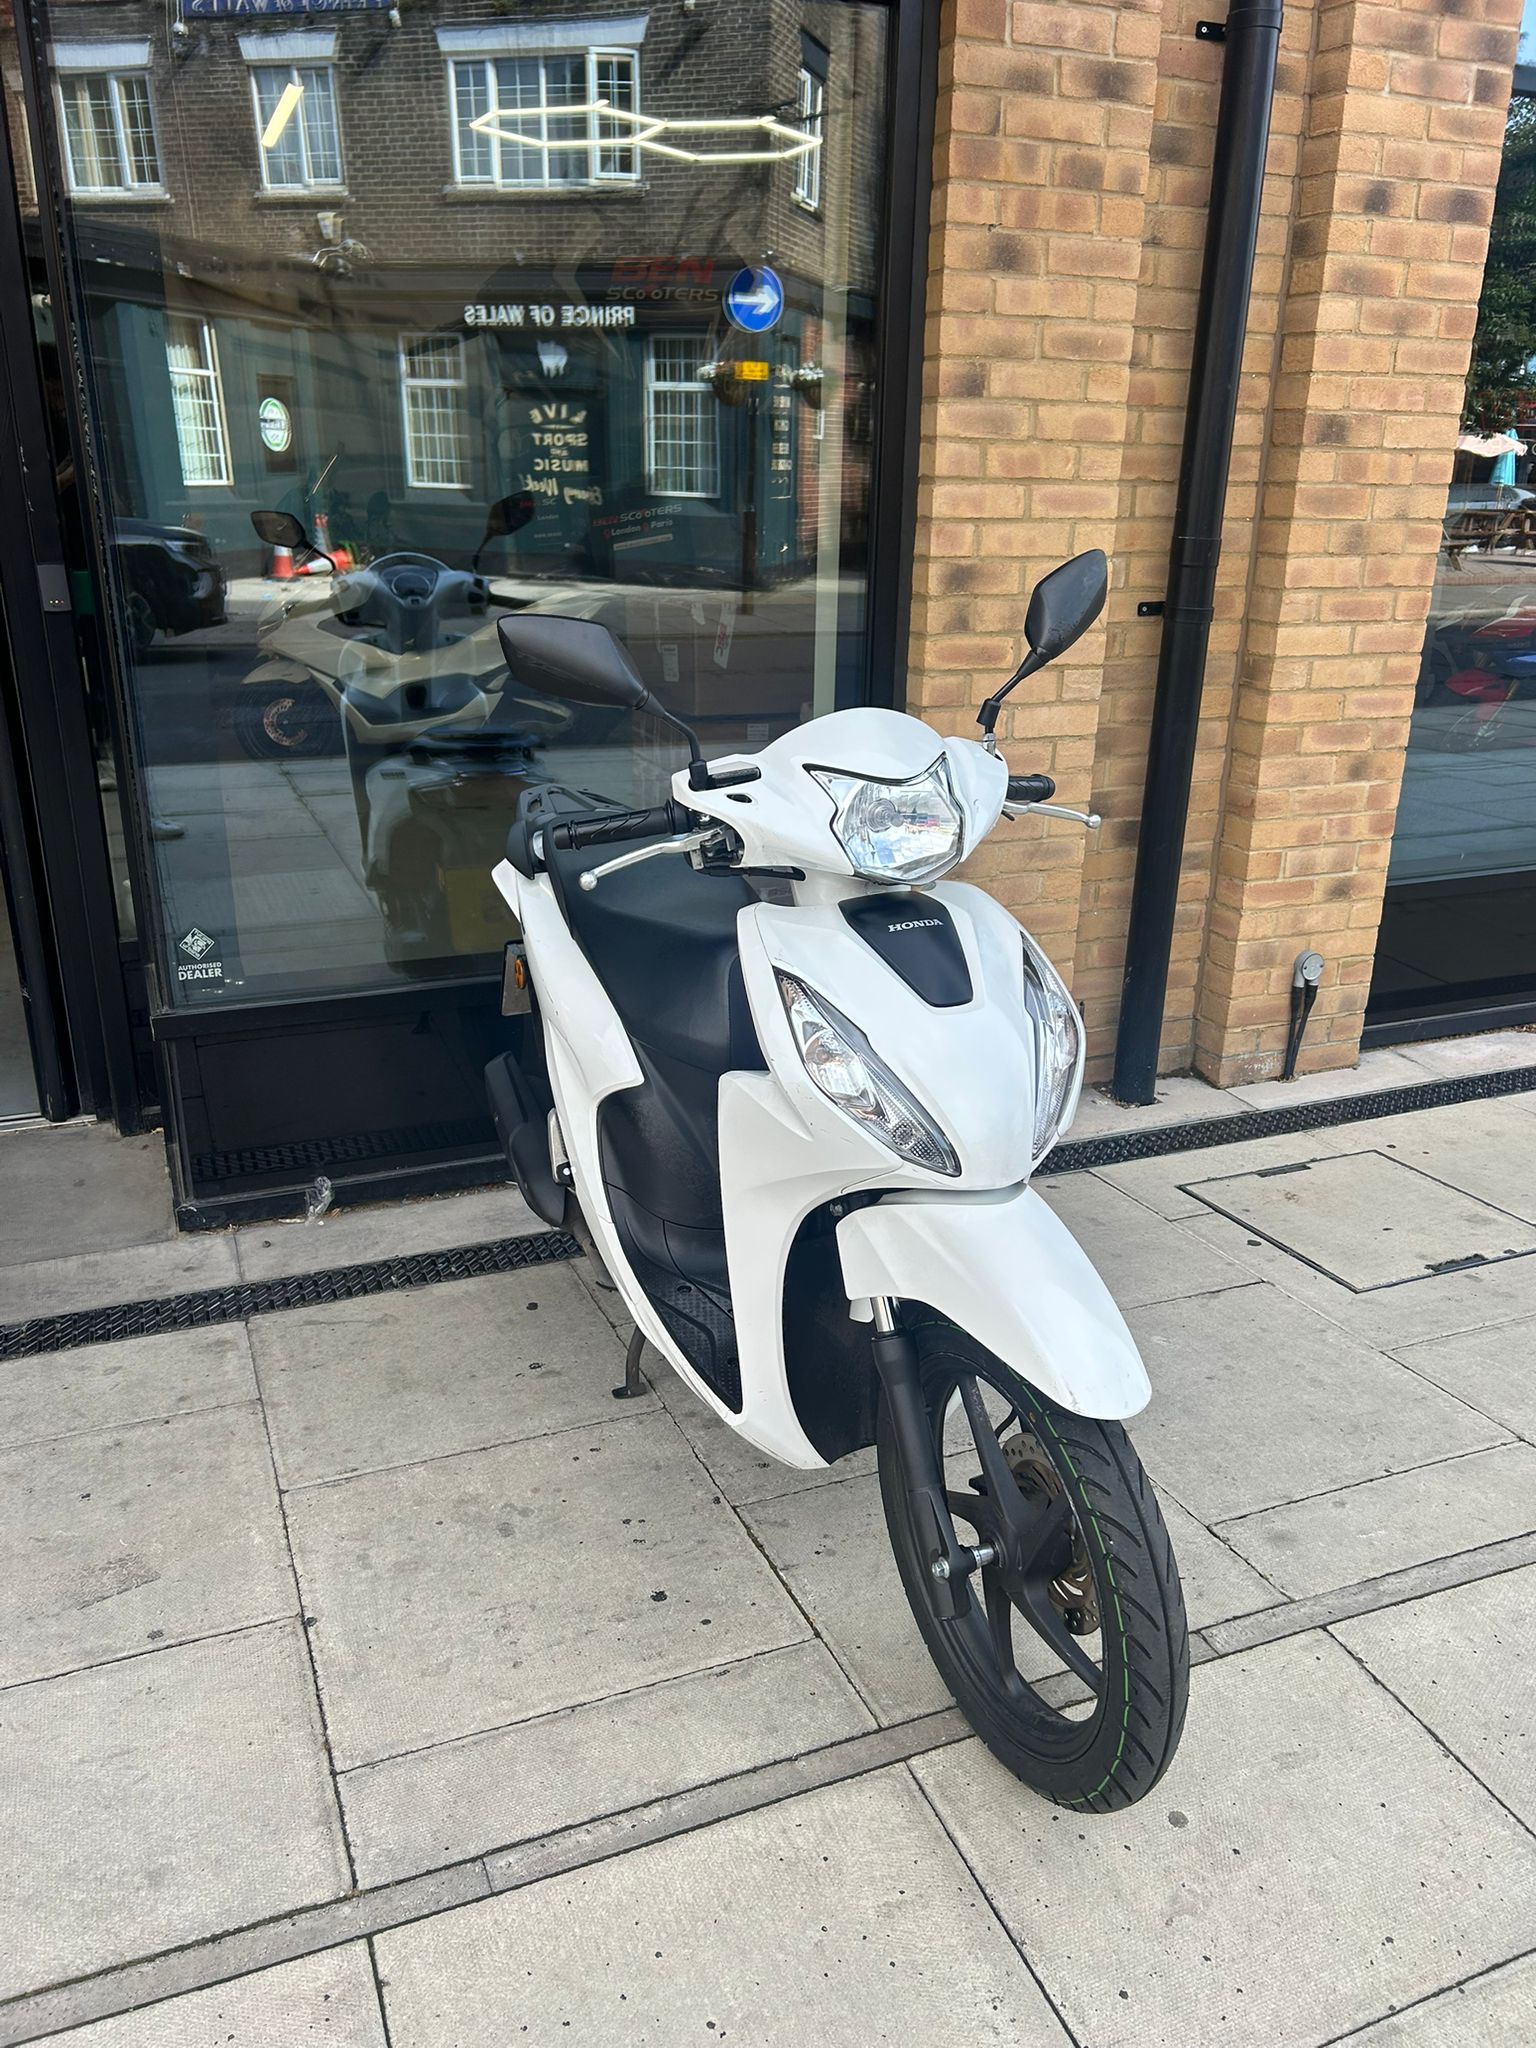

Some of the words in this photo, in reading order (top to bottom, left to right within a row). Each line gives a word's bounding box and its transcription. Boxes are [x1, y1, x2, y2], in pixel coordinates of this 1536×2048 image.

[611, 256, 717, 284] BEN
[611, 525, 641, 536] London
[887, 919, 943, 932] HONDA
[178, 962, 222, 971] AUTHORISED
[178, 968, 223, 980] DEALER
